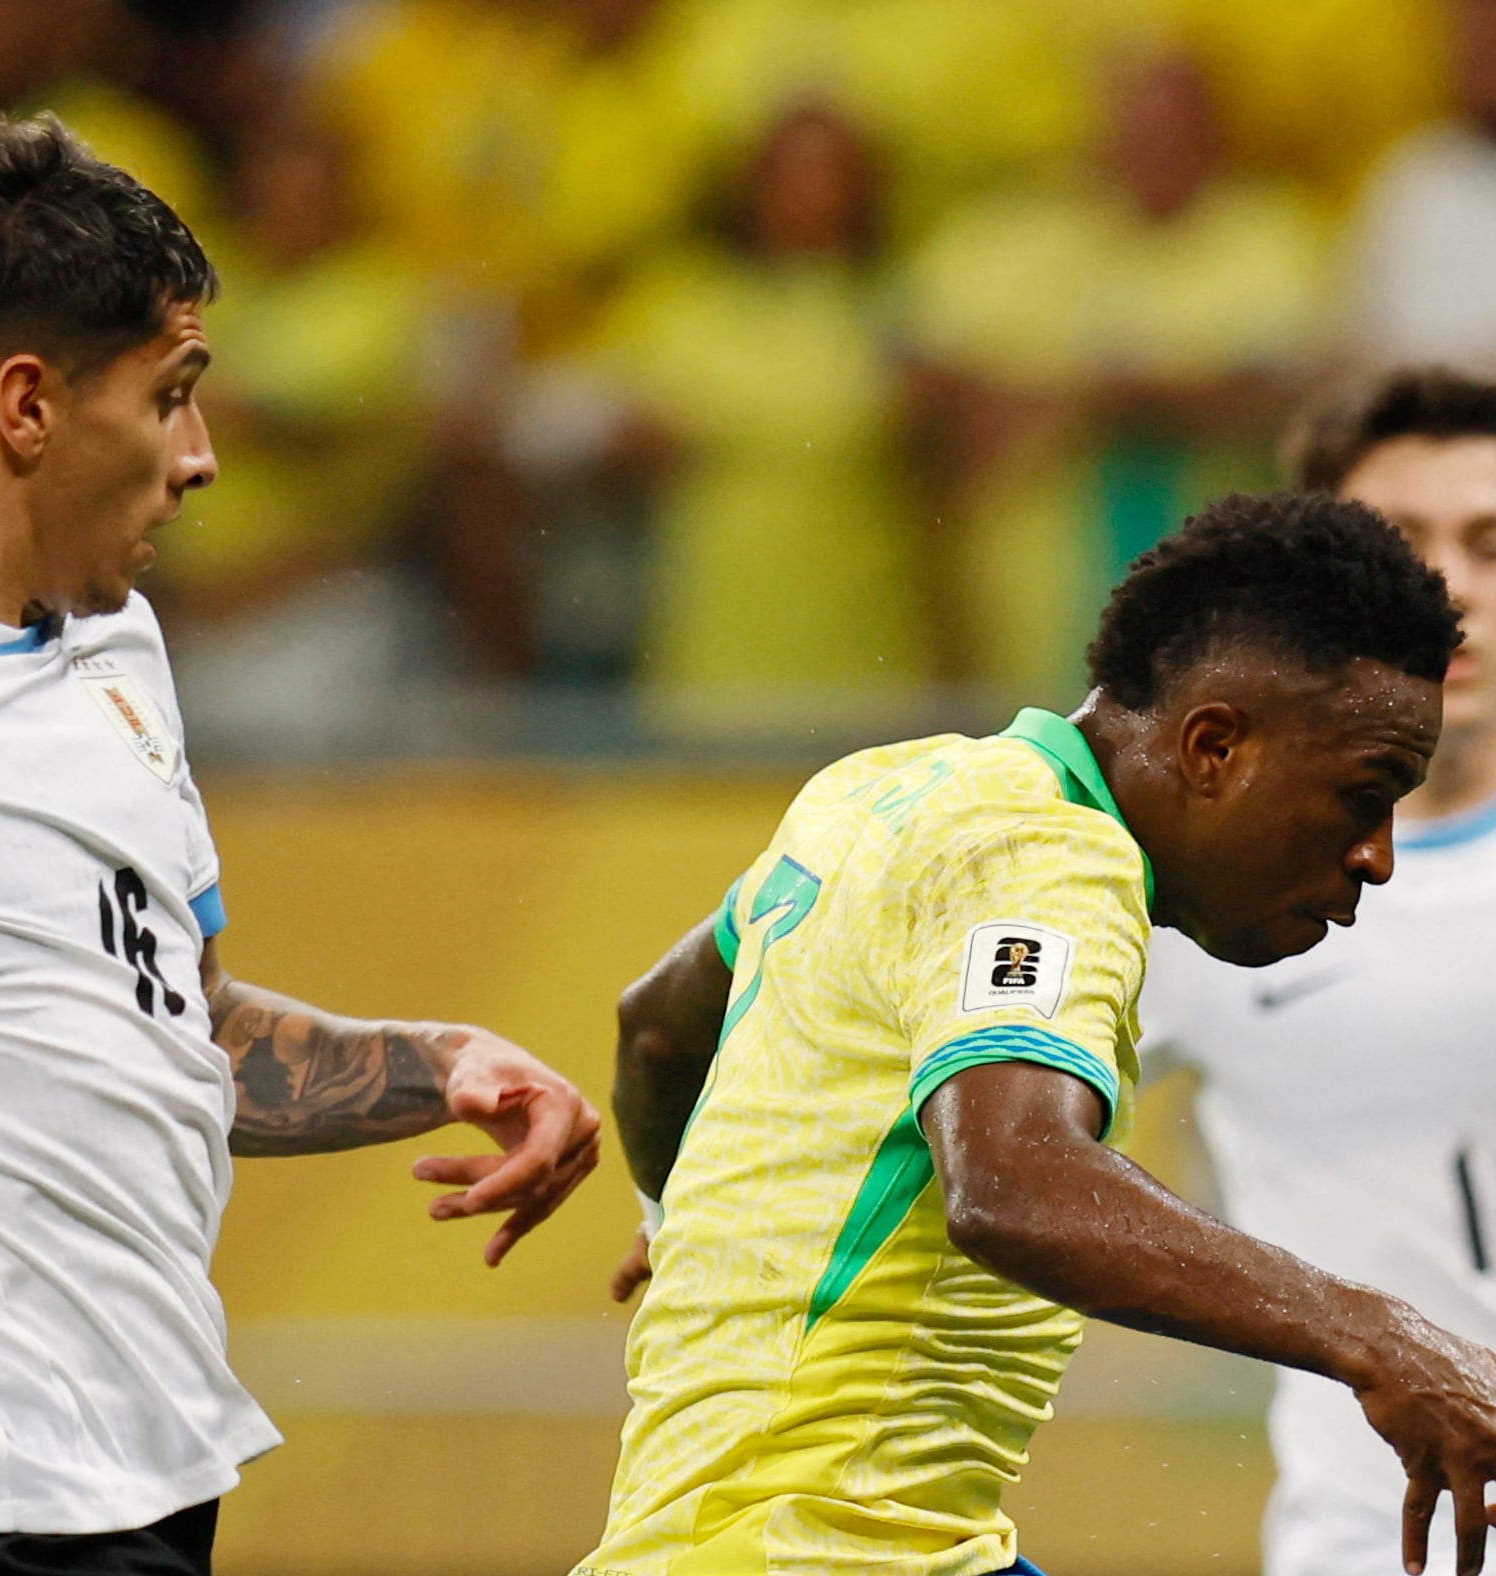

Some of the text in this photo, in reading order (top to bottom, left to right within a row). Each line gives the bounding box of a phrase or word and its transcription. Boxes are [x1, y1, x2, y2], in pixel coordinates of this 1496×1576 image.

[99, 867, 186, 1018] 16
[677, 854, 822, 1160] 7
[1002, 977, 1025, 985] FIFA
